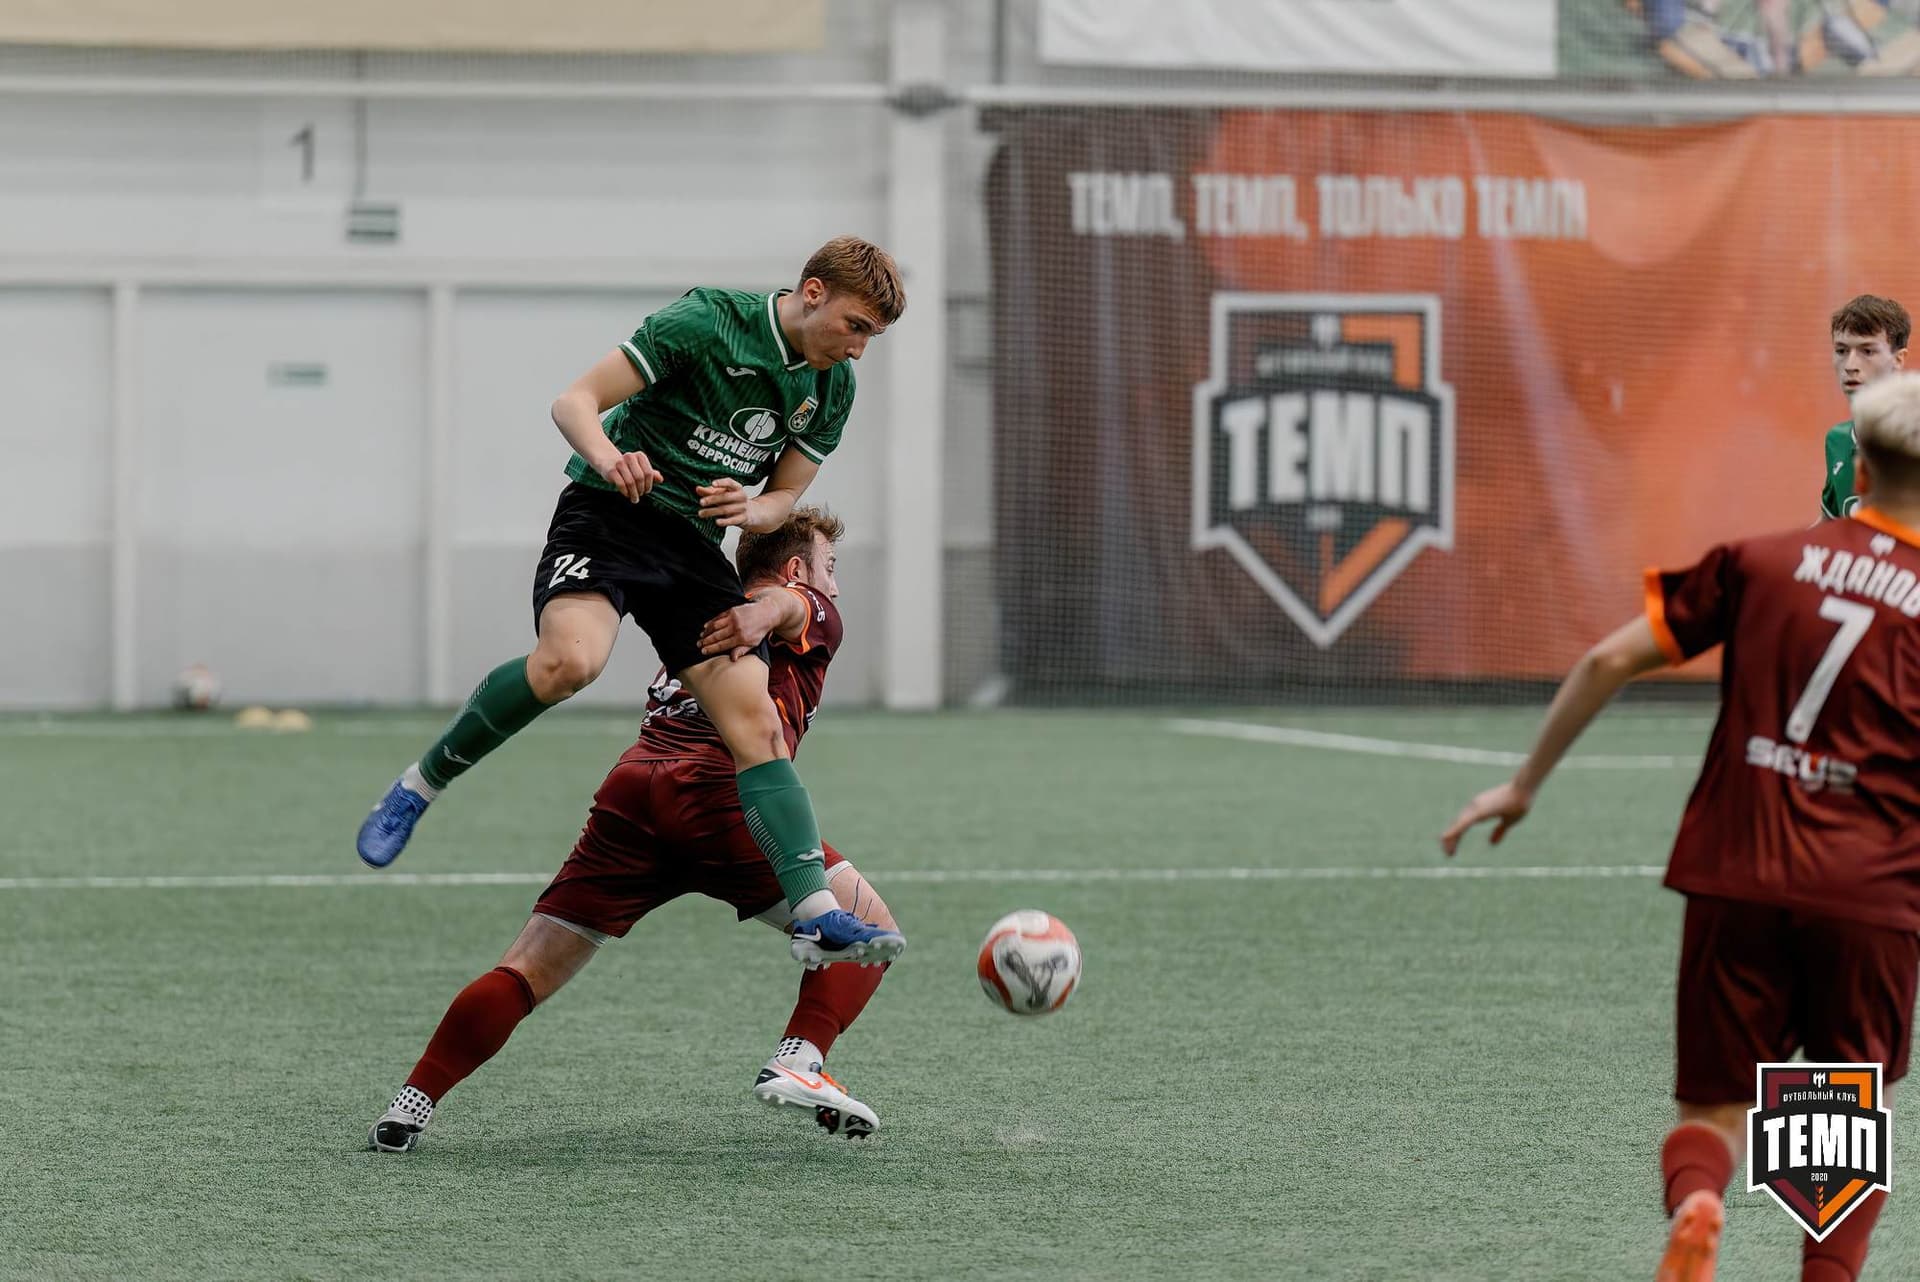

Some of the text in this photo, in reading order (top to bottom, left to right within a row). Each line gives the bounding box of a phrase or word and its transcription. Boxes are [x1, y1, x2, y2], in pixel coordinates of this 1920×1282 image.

[287, 122, 315, 182] 1
[1067, 173, 1186, 243] ТЕМП,
[1191, 173, 1309, 243] ТЕМП,
[1315, 174, 1466, 239] ТОЛЬКО
[1221, 389, 1430, 513] ТЕМП
[548, 553, 592, 589] 24
[1785, 595, 1875, 744] 7
